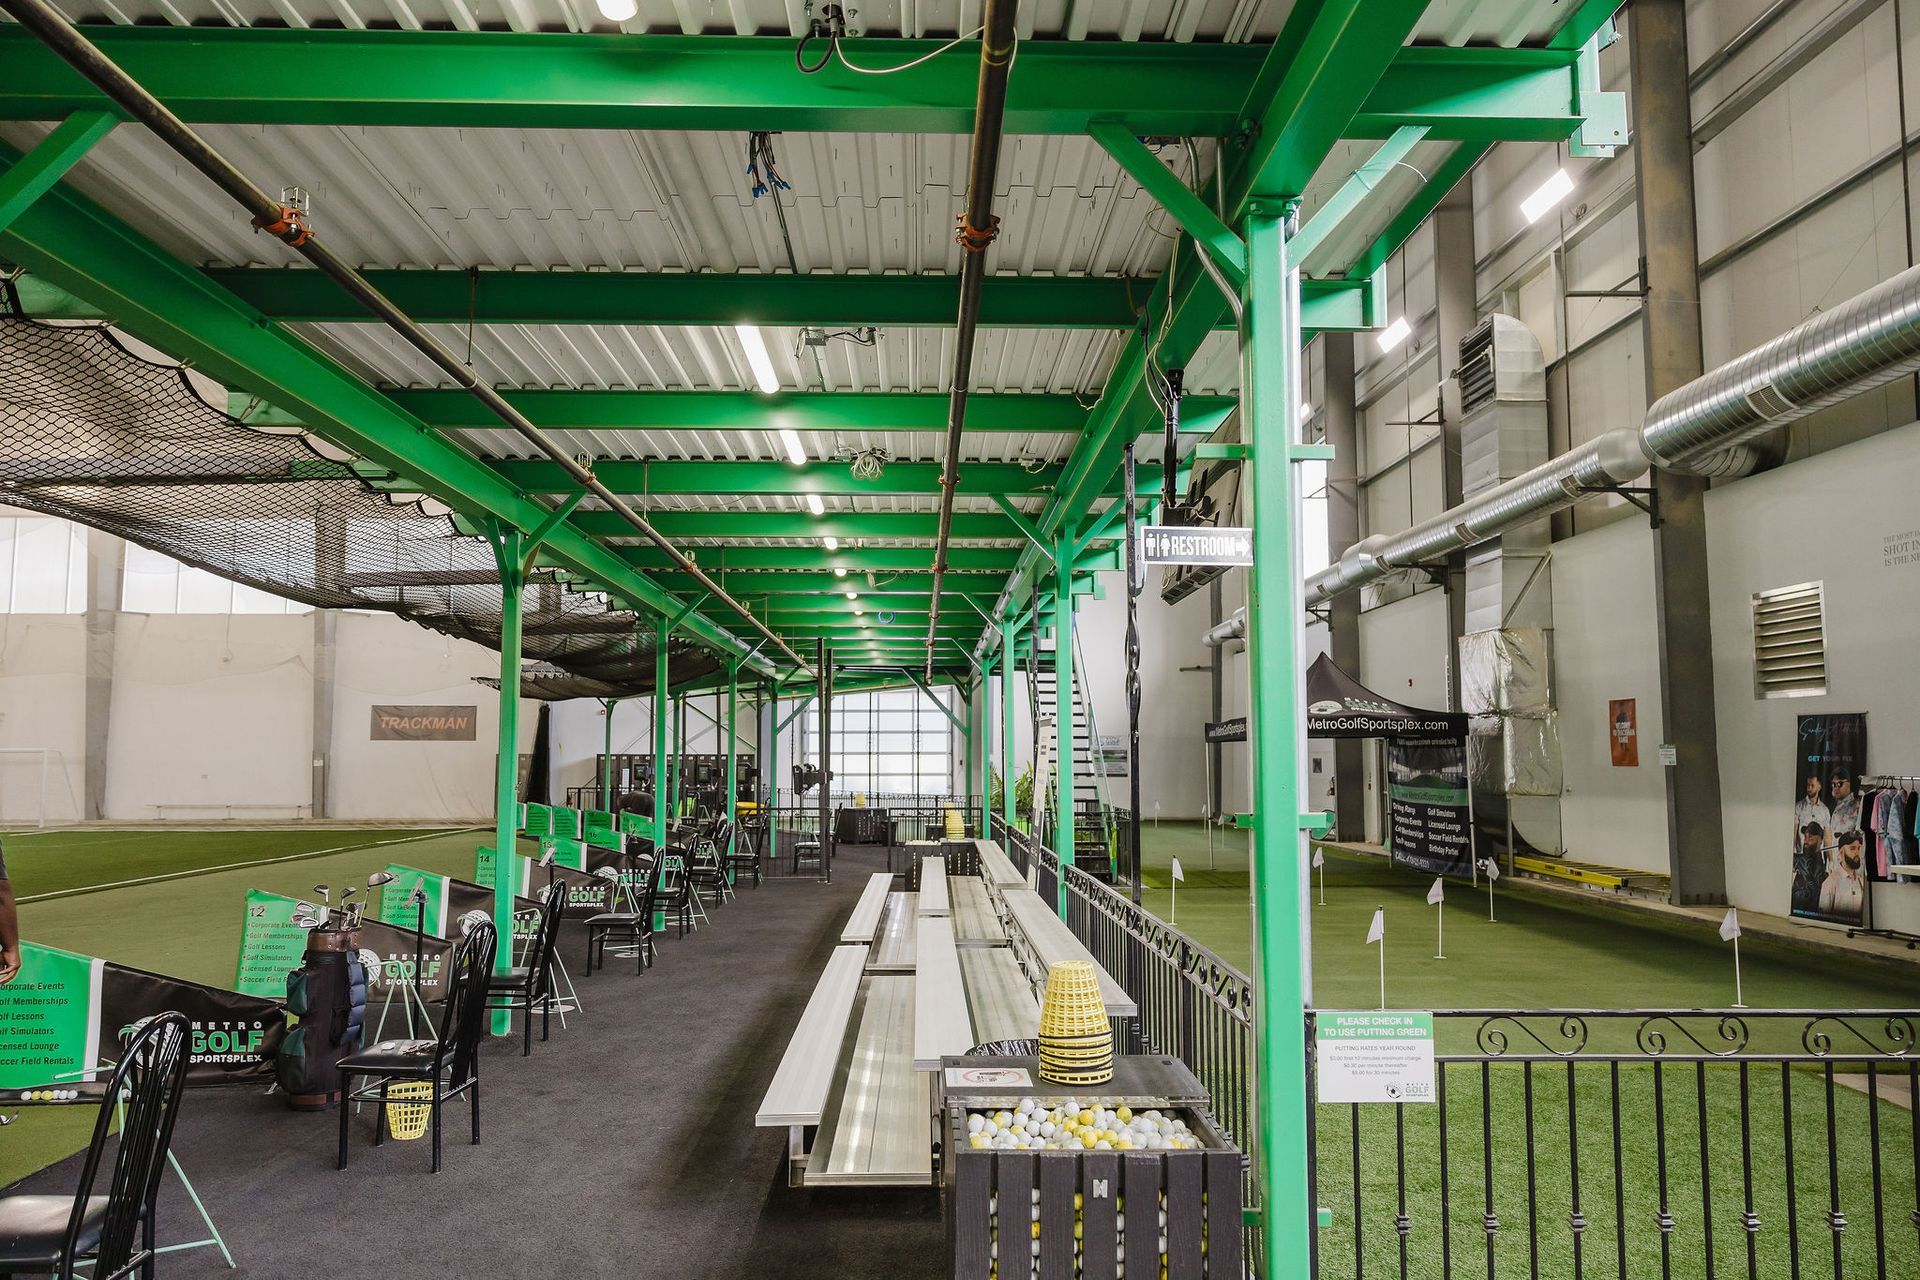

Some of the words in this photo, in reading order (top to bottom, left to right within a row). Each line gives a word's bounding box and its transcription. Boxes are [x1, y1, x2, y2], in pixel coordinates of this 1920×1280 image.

[1171, 535, 1236, 556] RESTROOM
[1884, 541, 1910, 556] SHOT
[1911, 552, 1920, 562] NE
[380, 716, 468, 729] TRACKMAN
[1307, 717, 1449, 731] MetroGolfSportsplex.com
[480, 855, 490, 863] 14
[568, 891, 606, 902] GOLF
[249, 905, 265, 917] 12
[513, 920, 540, 934] OLF
[264, 932, 303, 940] Memberships
[389, 953, 441, 961] METRO
[0, 983, 35, 992] orporate
[37, 982, 65, 990] Events
[0, 998, 10, 1006] olf
[13, 997, 69, 1006] Memberships
[0, 1012, 9, 1020] olf
[12, 1012, 45, 1020] Lessons
[191, 1020, 263, 1030] METRO
[1336, 1017, 1370, 1026] PLEASE
[1371, 1017, 1402, 1026] CHECK
[1403, 1017, 1413, 1025] IN
[10, 1027, 55, 1035] Simulators
[1324, 1028, 1337, 1036] TO
[1338, 1028, 1356, 1036] USE
[1357, 1028, 1395, 1036] PUTTING
[1397, 1028, 1427, 1036] GREEN
[0, 1042, 28, 1051] censed
[30, 1042, 60, 1051] Lounge
[191, 1030, 265, 1053] GOLF
[0, 1058, 18, 1066] ccer
[21, 1056, 42, 1065] Field
[43, 1056, 75, 1065] Rentals
[189, 1053, 263, 1064] SPORTSPLEX
[1405, 1086, 1430, 1094] GOLF
